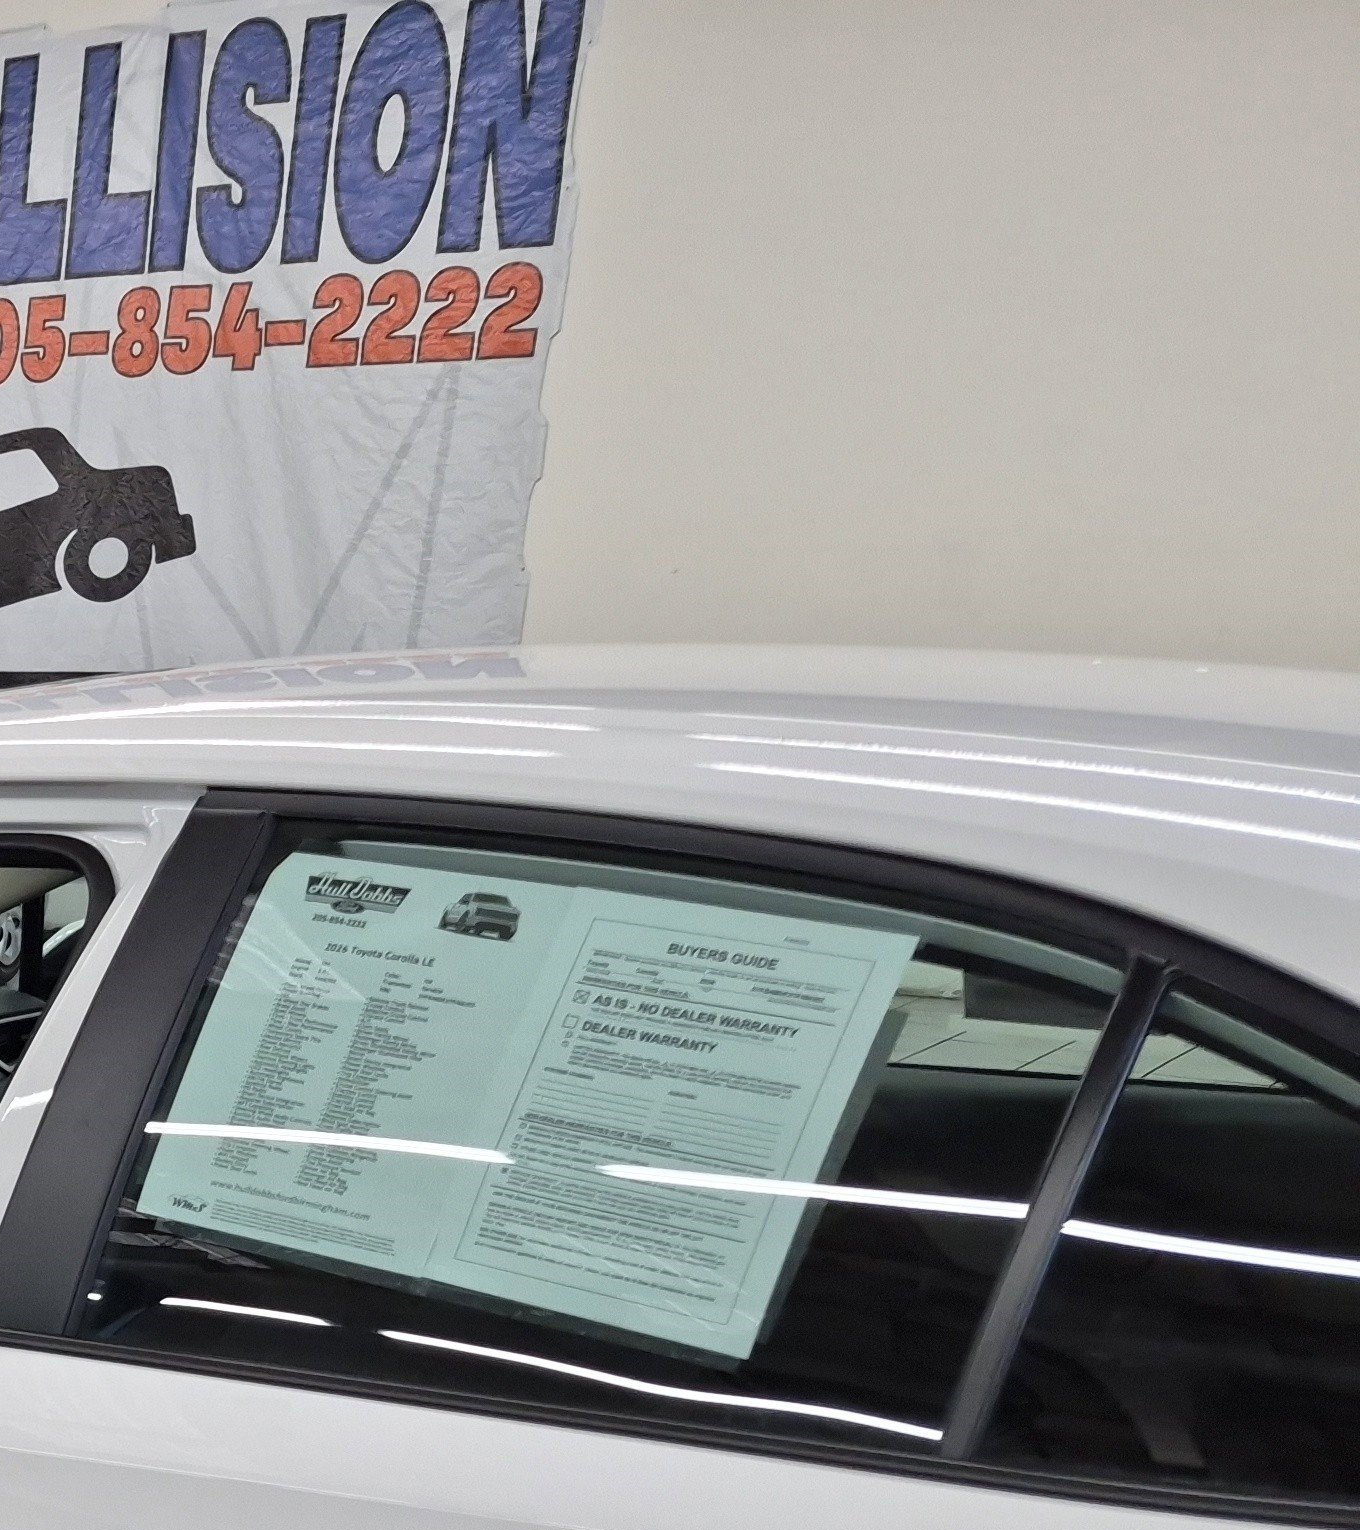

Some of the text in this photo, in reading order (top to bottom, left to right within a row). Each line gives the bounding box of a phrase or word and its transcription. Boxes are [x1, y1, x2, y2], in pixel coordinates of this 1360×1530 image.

[349, 877, 404, 905] Dobbs
[351, 947, 383, 959] Toyota
[384, 951, 420, 965] Corolla
[666, 942, 728, 962] BUYERS
[730, 952, 780, 971] GUIDE
[592, 994, 613, 1007] AS
[637, 1001, 660, 1015] NO
[661, 1006, 717, 1025] DEALER
[719, 1014, 800, 1038] WARRANTY
[581, 1020, 719, 1054] DEALER WARRANTY
